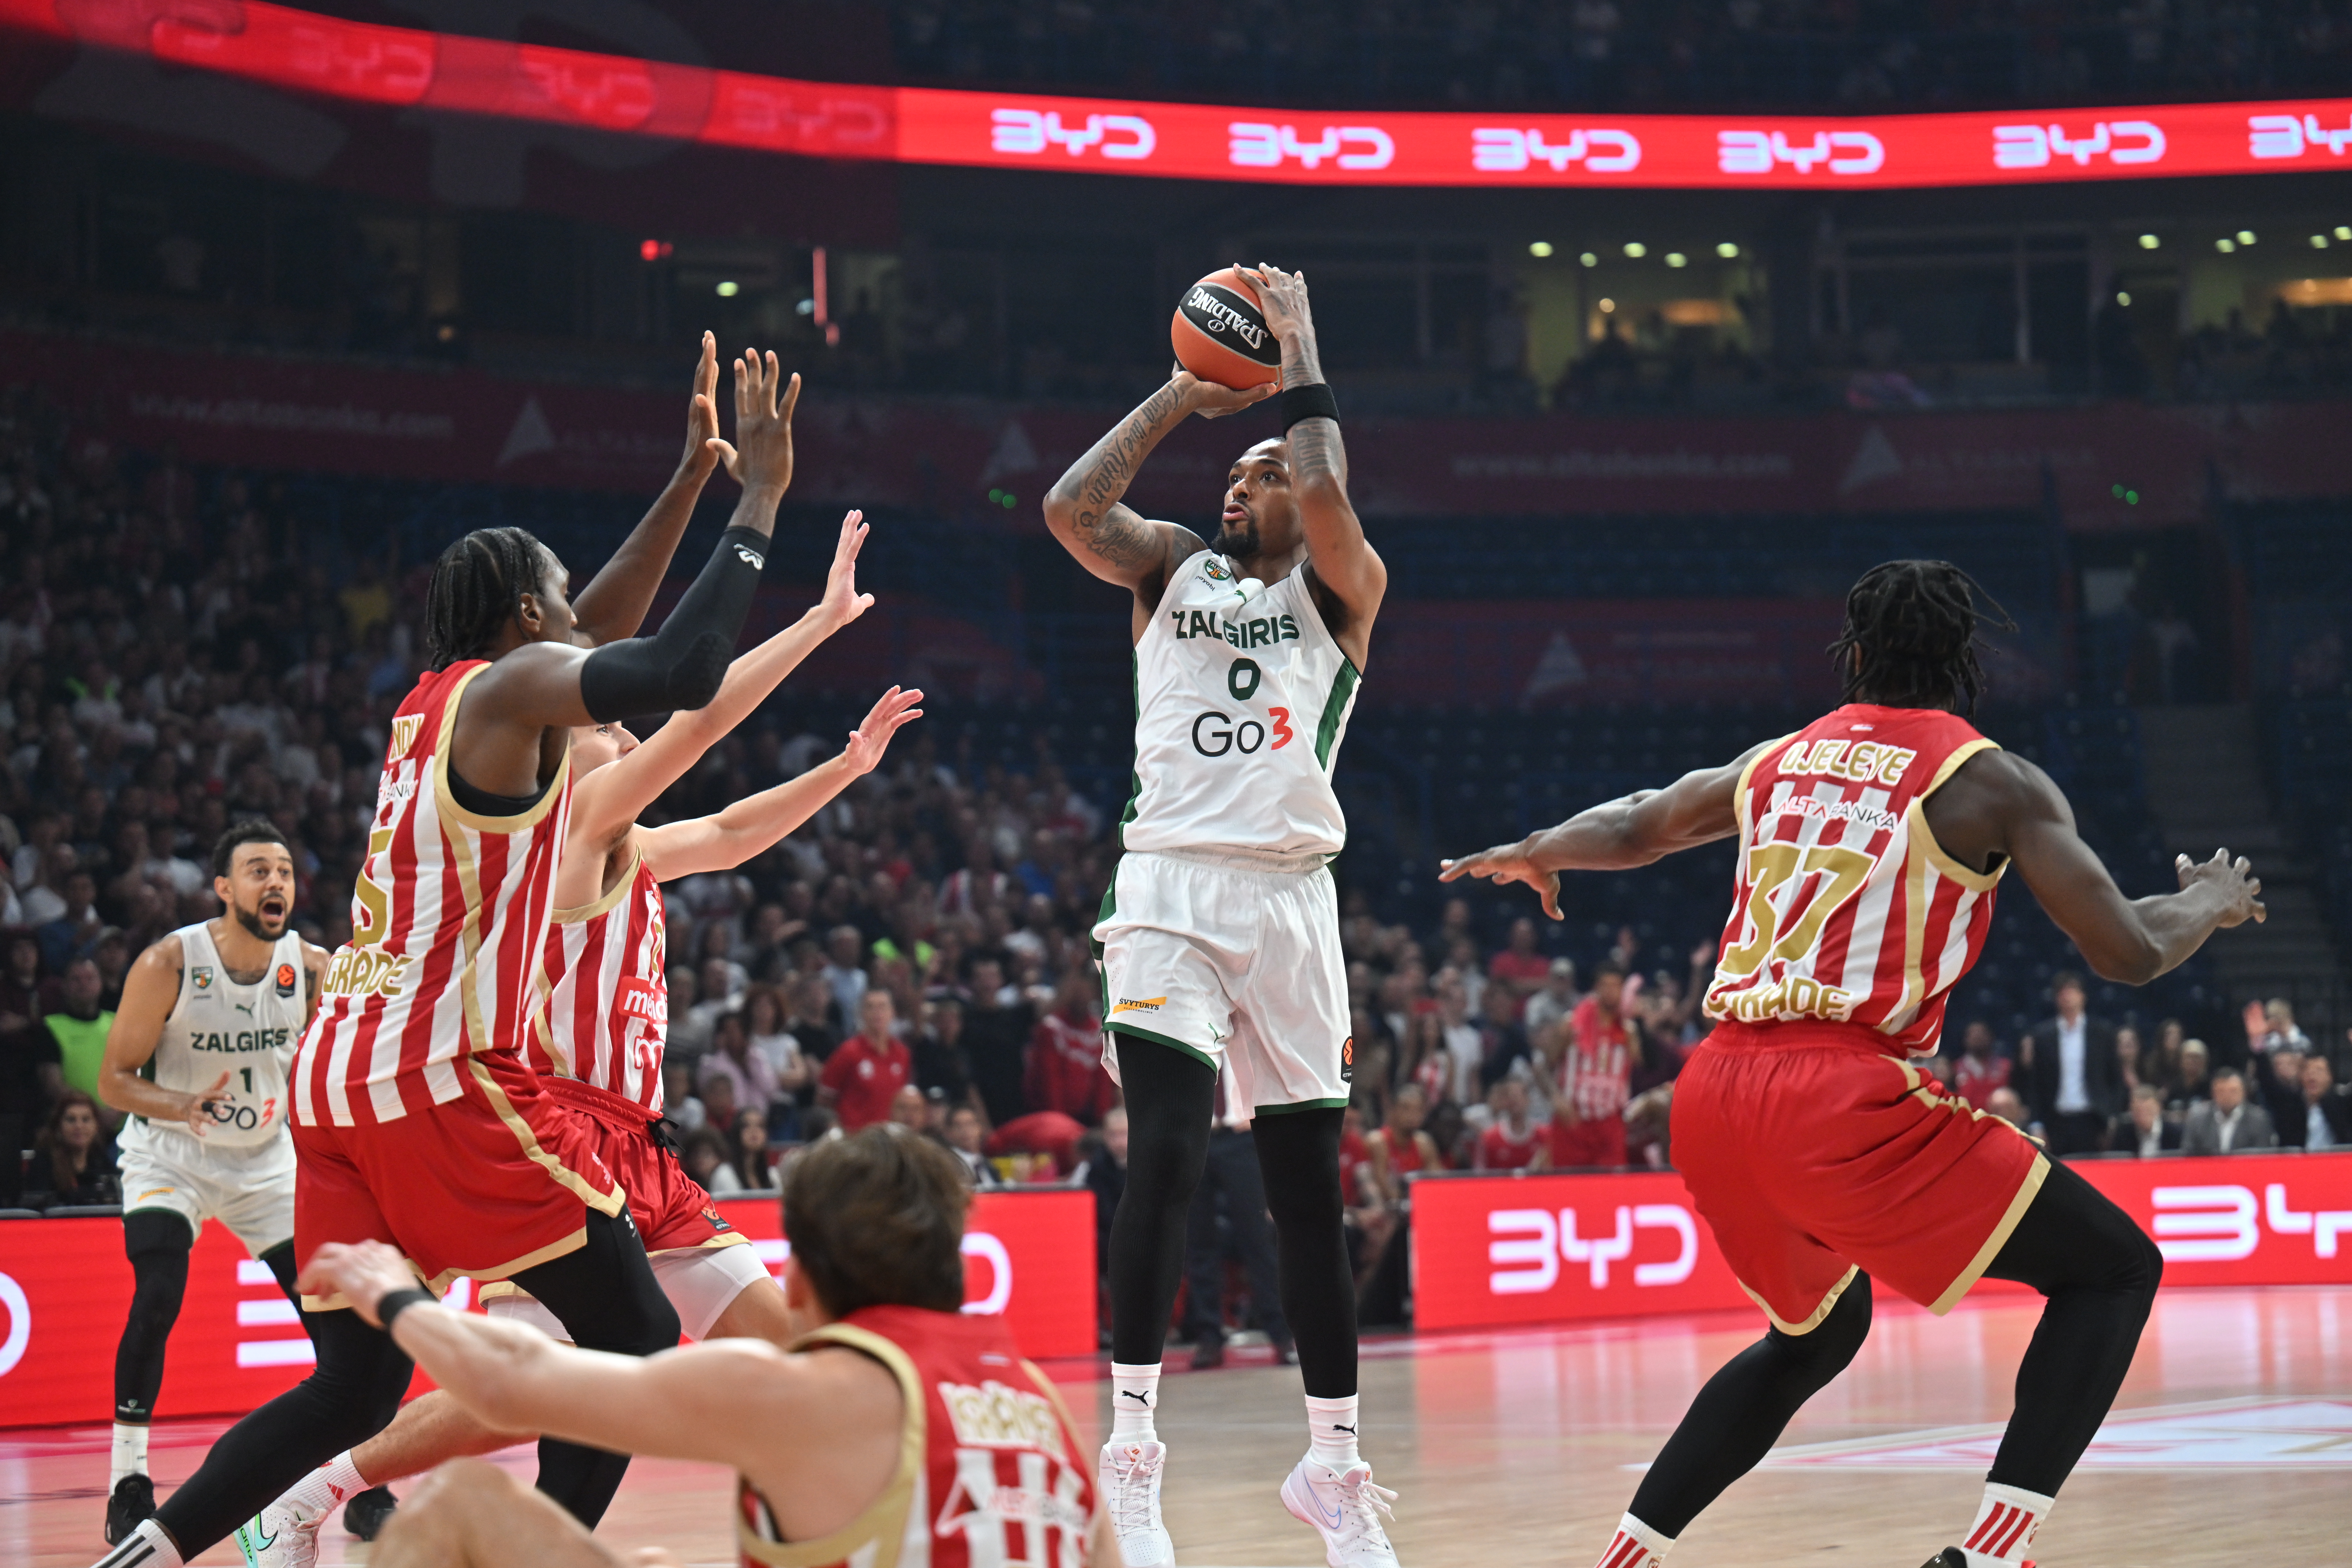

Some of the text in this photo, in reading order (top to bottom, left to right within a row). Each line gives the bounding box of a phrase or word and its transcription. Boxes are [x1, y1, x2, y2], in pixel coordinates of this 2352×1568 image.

[991, 107, 1156, 160] BYD
[1227, 121, 1396, 170] BYD
[1471, 127, 1642, 173] BYD
[1718, 129, 1885, 175] BYD
[1993, 120, 2167, 169] BYD
[2248, 114, 2352, 159] BY
[1188, 287, 1269, 349] SPALDING
[1207, 560, 1230, 578] ZALGIRIS
[1172, 610, 1300, 648] ZALGIRIS
[1192, 707, 1293, 757] Go3
[1779, 740, 1916, 784] OJELEYE
[1775, 796, 1898, 831] ALTABANKA
[1714, 840, 1878, 975] 37
[1119, 997, 1159, 1010] ŠVYTURYS
[240, 1067, 251, 1093] 1
[2151, 1183, 2352, 1263] BY
[1488, 1203, 1698, 1295] BYD
